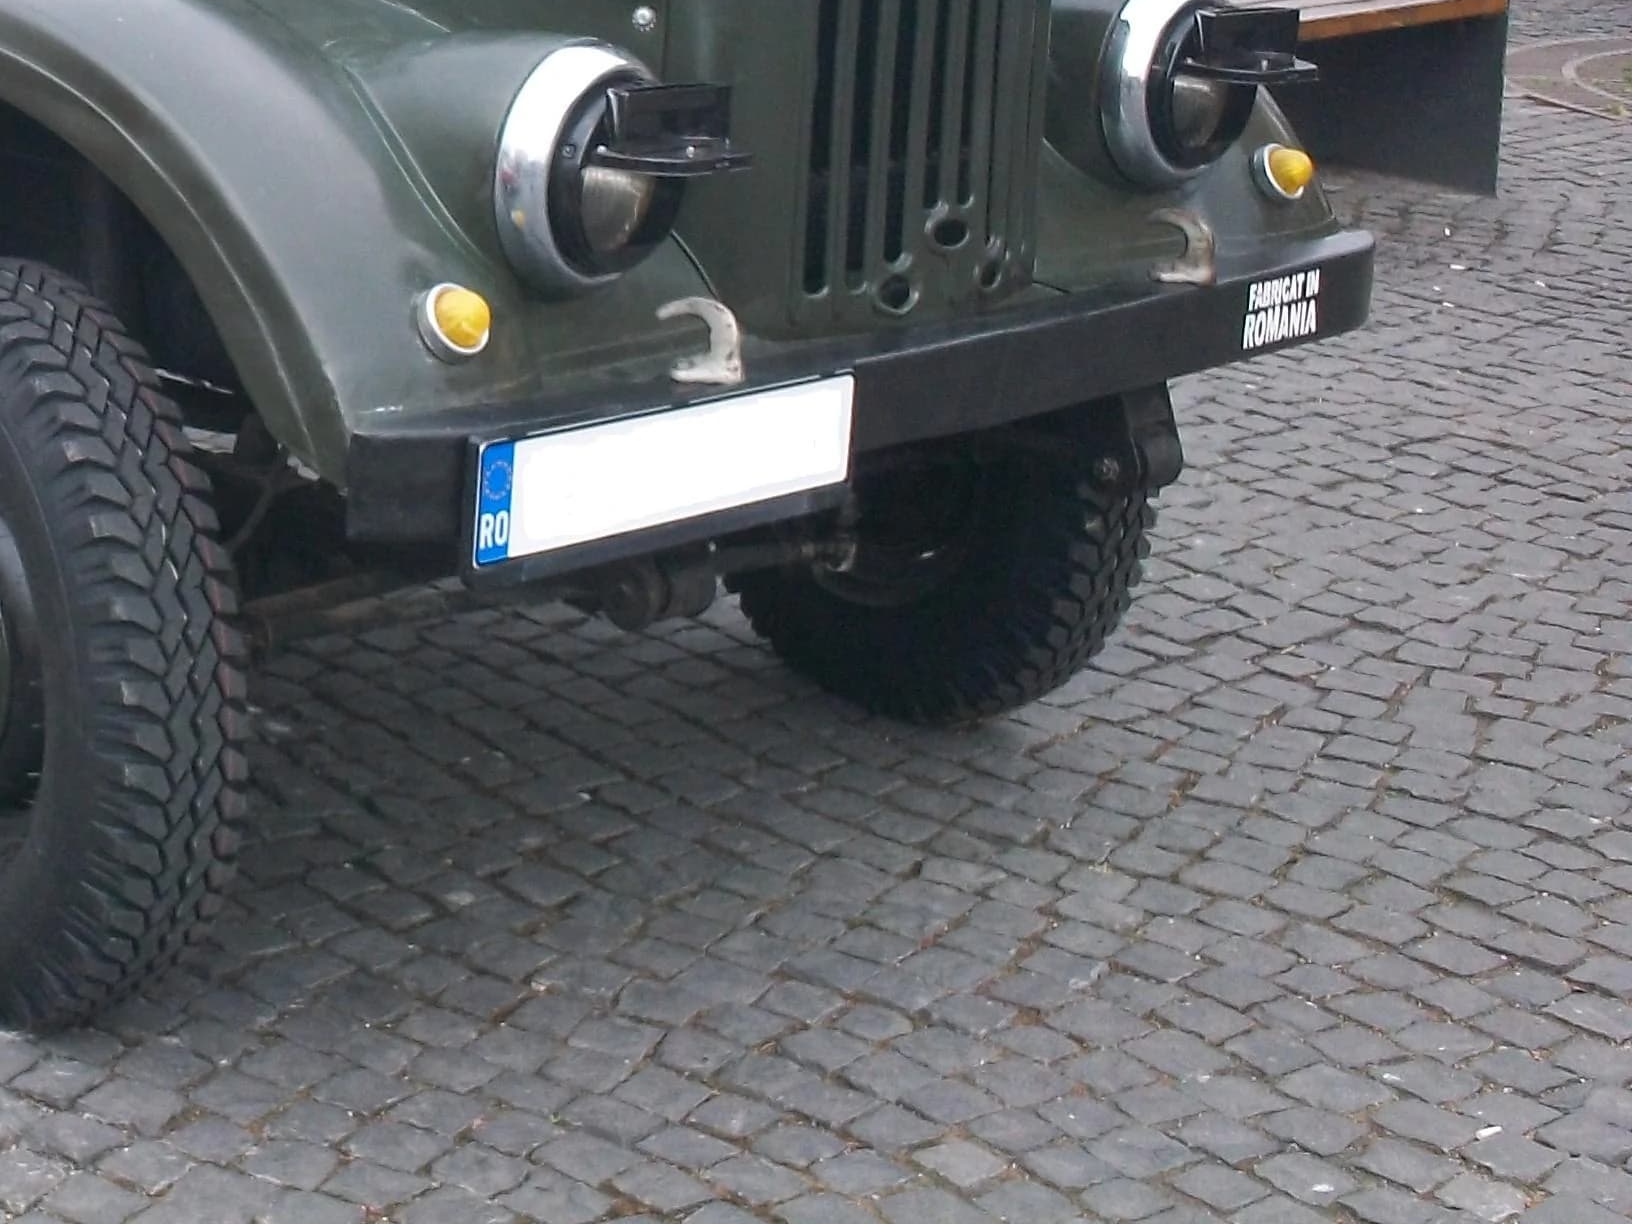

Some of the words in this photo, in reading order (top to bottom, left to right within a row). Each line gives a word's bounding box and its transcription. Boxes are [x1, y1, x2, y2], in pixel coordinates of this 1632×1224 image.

[1248, 272, 1303, 311] FABRICAT
[1305, 269, 1320, 298] IN
[1243, 299, 1317, 350] ROMANIA
[478, 509, 509, 550] RO
